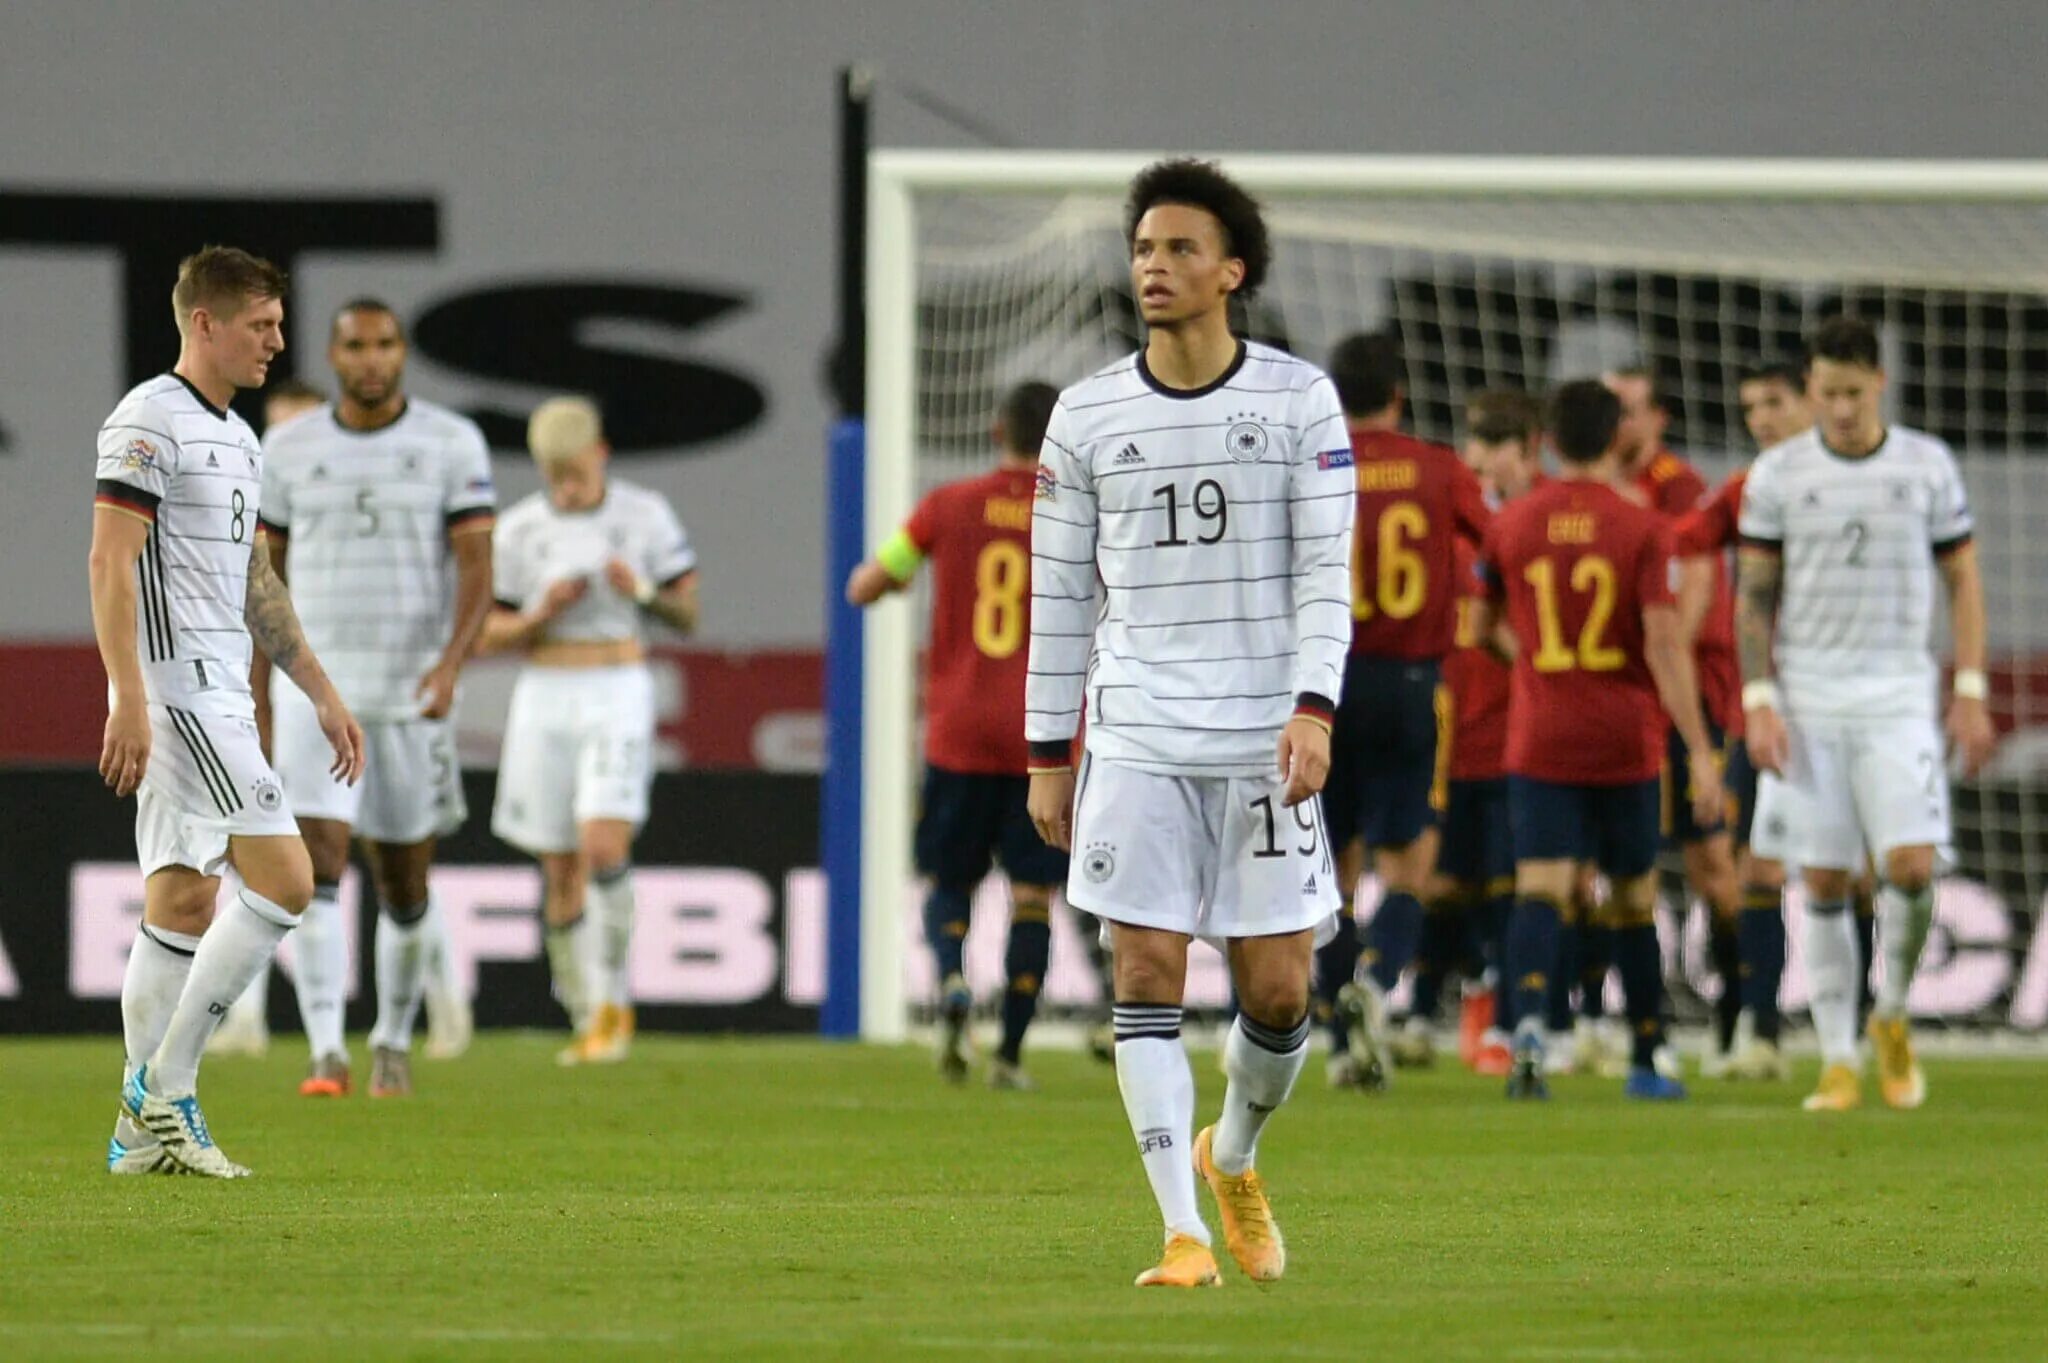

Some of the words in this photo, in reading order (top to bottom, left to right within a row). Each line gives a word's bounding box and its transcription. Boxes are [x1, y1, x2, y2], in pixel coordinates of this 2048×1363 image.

[231, 488, 245, 543] 8
[356, 489, 380, 540] 5
[1153, 478, 1228, 548] 19
[1843, 519, 1868, 568] 2
[972, 539, 1028, 660] 8
[1524, 555, 1626, 673] 12
[1249, 794, 1317, 858] 19
